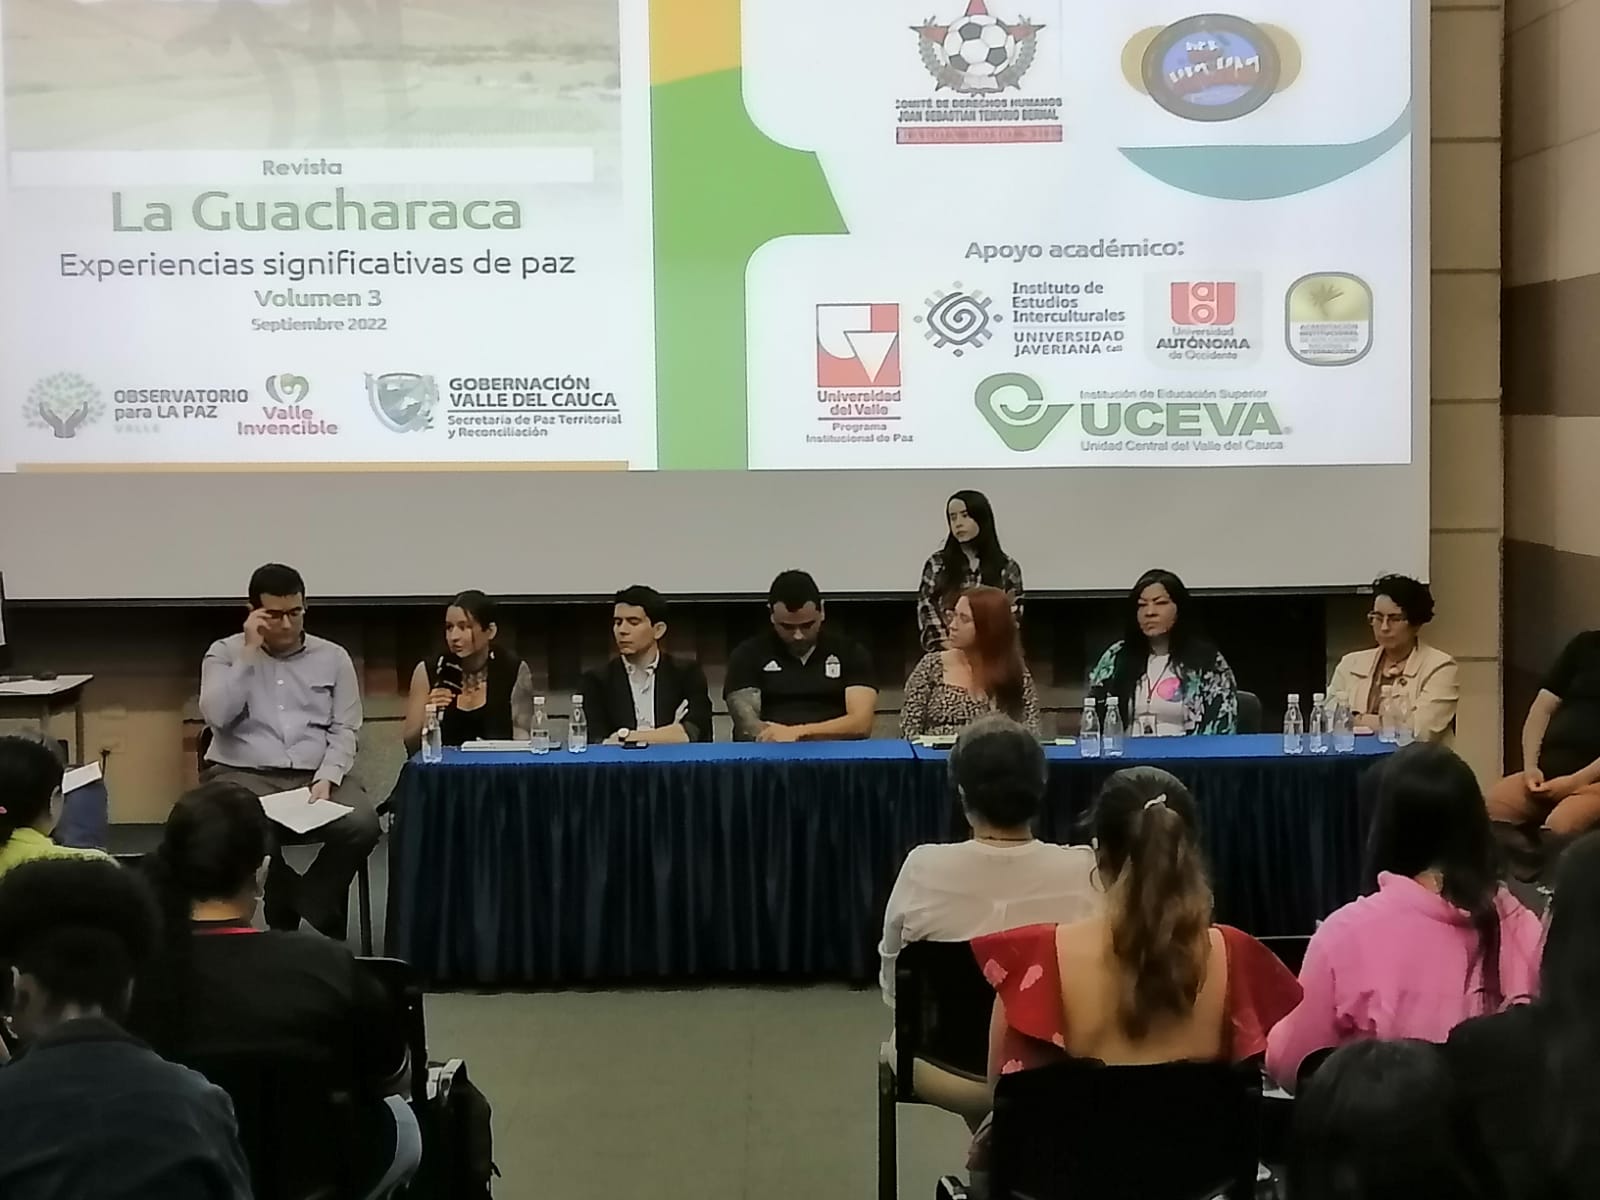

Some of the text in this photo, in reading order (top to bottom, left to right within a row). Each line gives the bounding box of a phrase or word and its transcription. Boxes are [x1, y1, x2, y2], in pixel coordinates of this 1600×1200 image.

[262, 158, 342, 175] Revista
[112, 187, 521, 232] La Guacharaca
[964, 238, 1185, 263] Apoyo académico:
[60, 249, 576, 282] Experiencias significativas de paz
[1012, 281, 1104, 294] Instituto de
[254, 288, 382, 307] Volumen 3
[1012, 296, 1078, 309] Estudios
[1012, 309, 1126, 323] Interculturales
[251, 317, 387, 332] Septiembre 2022
[1014, 331, 1124, 343] UNIVERSIDAD
[1156, 336, 1250, 349] AUTÓNOMA
[1014, 344, 1101, 358] JAVERIANA
[449, 375, 590, 391] GOBERNACIÓN
[114, 389, 248, 403] OBSERVATORIO
[449, 392, 617, 407] VALLE DEL CAUCA
[817, 390, 901, 402] Universidad
[114, 405, 218, 422] para LA PAZ
[262, 405, 313, 420] Valle
[830, 404, 889, 416] del Valle
[515, 414, 530, 425] de
[533, 414, 555, 425] Paz
[558, 413, 622, 425] Territorial
[1081, 401, 1283, 437] UCEVA
[237, 421, 338, 435] Invencible
[832, 423, 887, 433] Programa
[1081, 441, 1123, 452] Unidad
[1125, 440, 1168, 452] Central
[1171, 440, 1189, 451] del
[1224, 440, 1241, 451] del
[1245, 439, 1284, 450] Cauca
